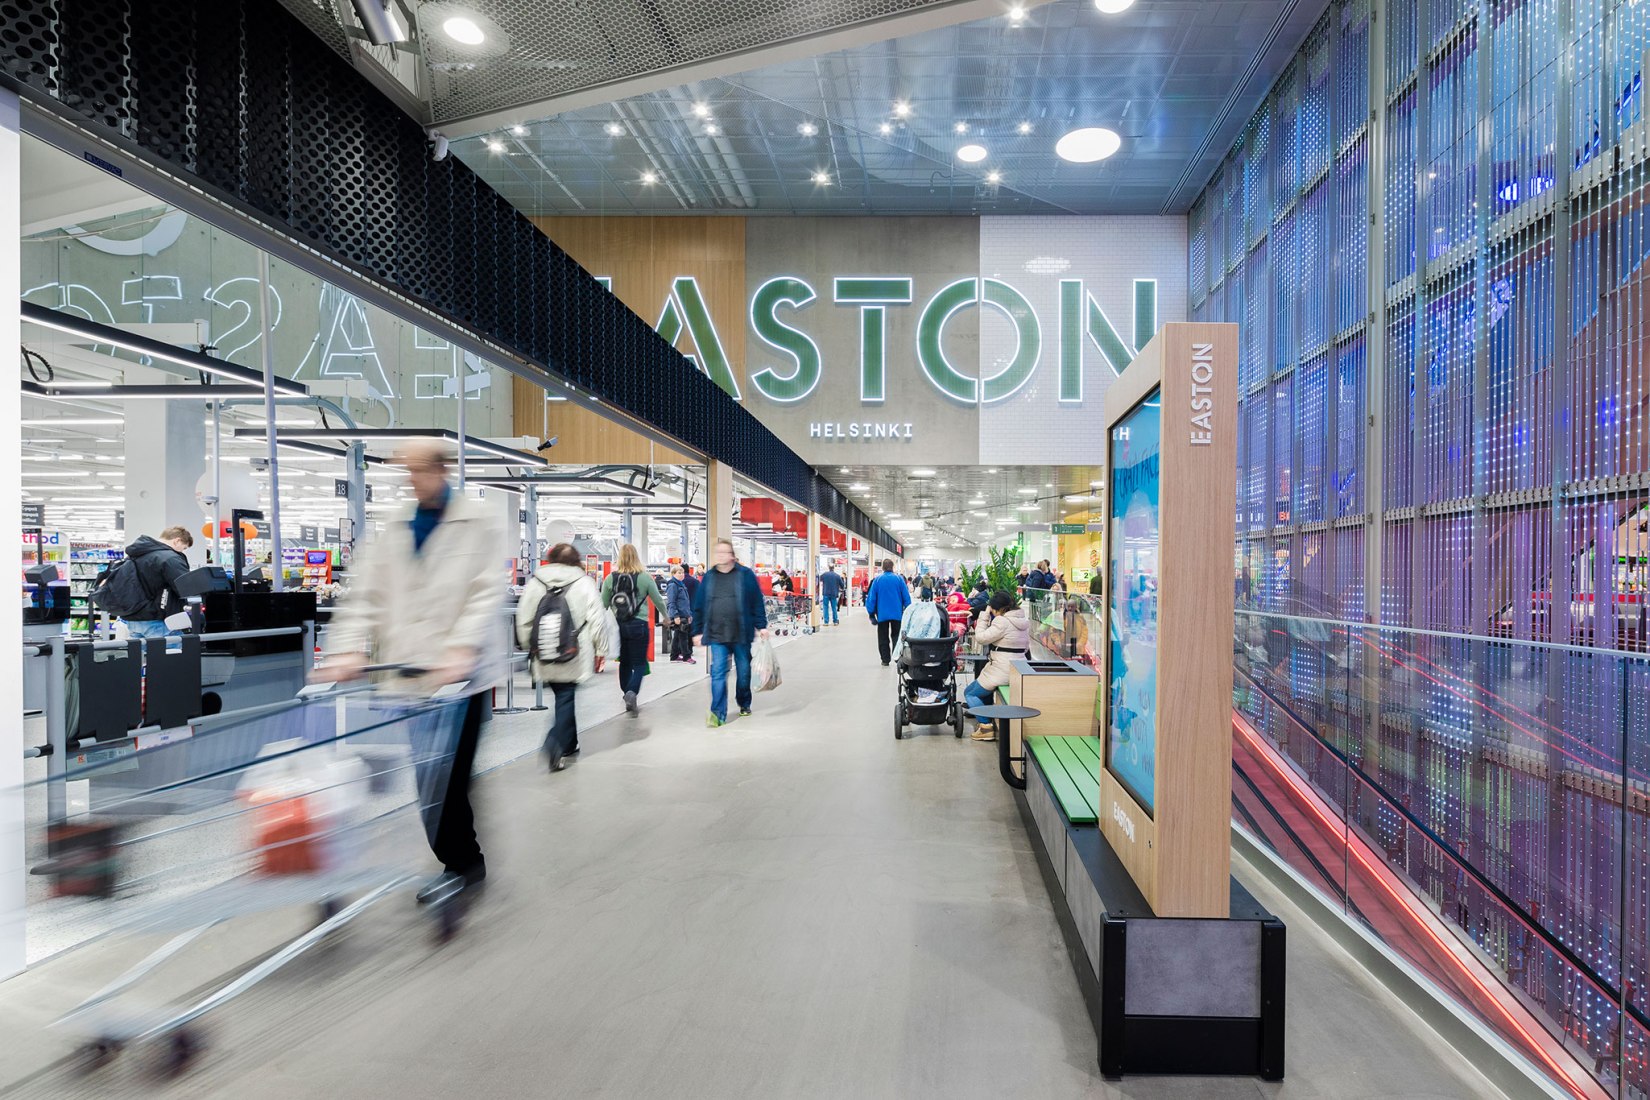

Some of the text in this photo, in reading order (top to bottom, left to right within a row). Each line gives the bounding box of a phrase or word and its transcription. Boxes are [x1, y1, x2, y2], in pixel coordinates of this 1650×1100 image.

[546, 276, 1158, 404] ASTON
[1190, 343, 1213, 444] EASTON
[810, 422, 913, 438] HELSINKI
[337, 484, 346, 495] 18
[1083, 572, 1089, 580] 2
